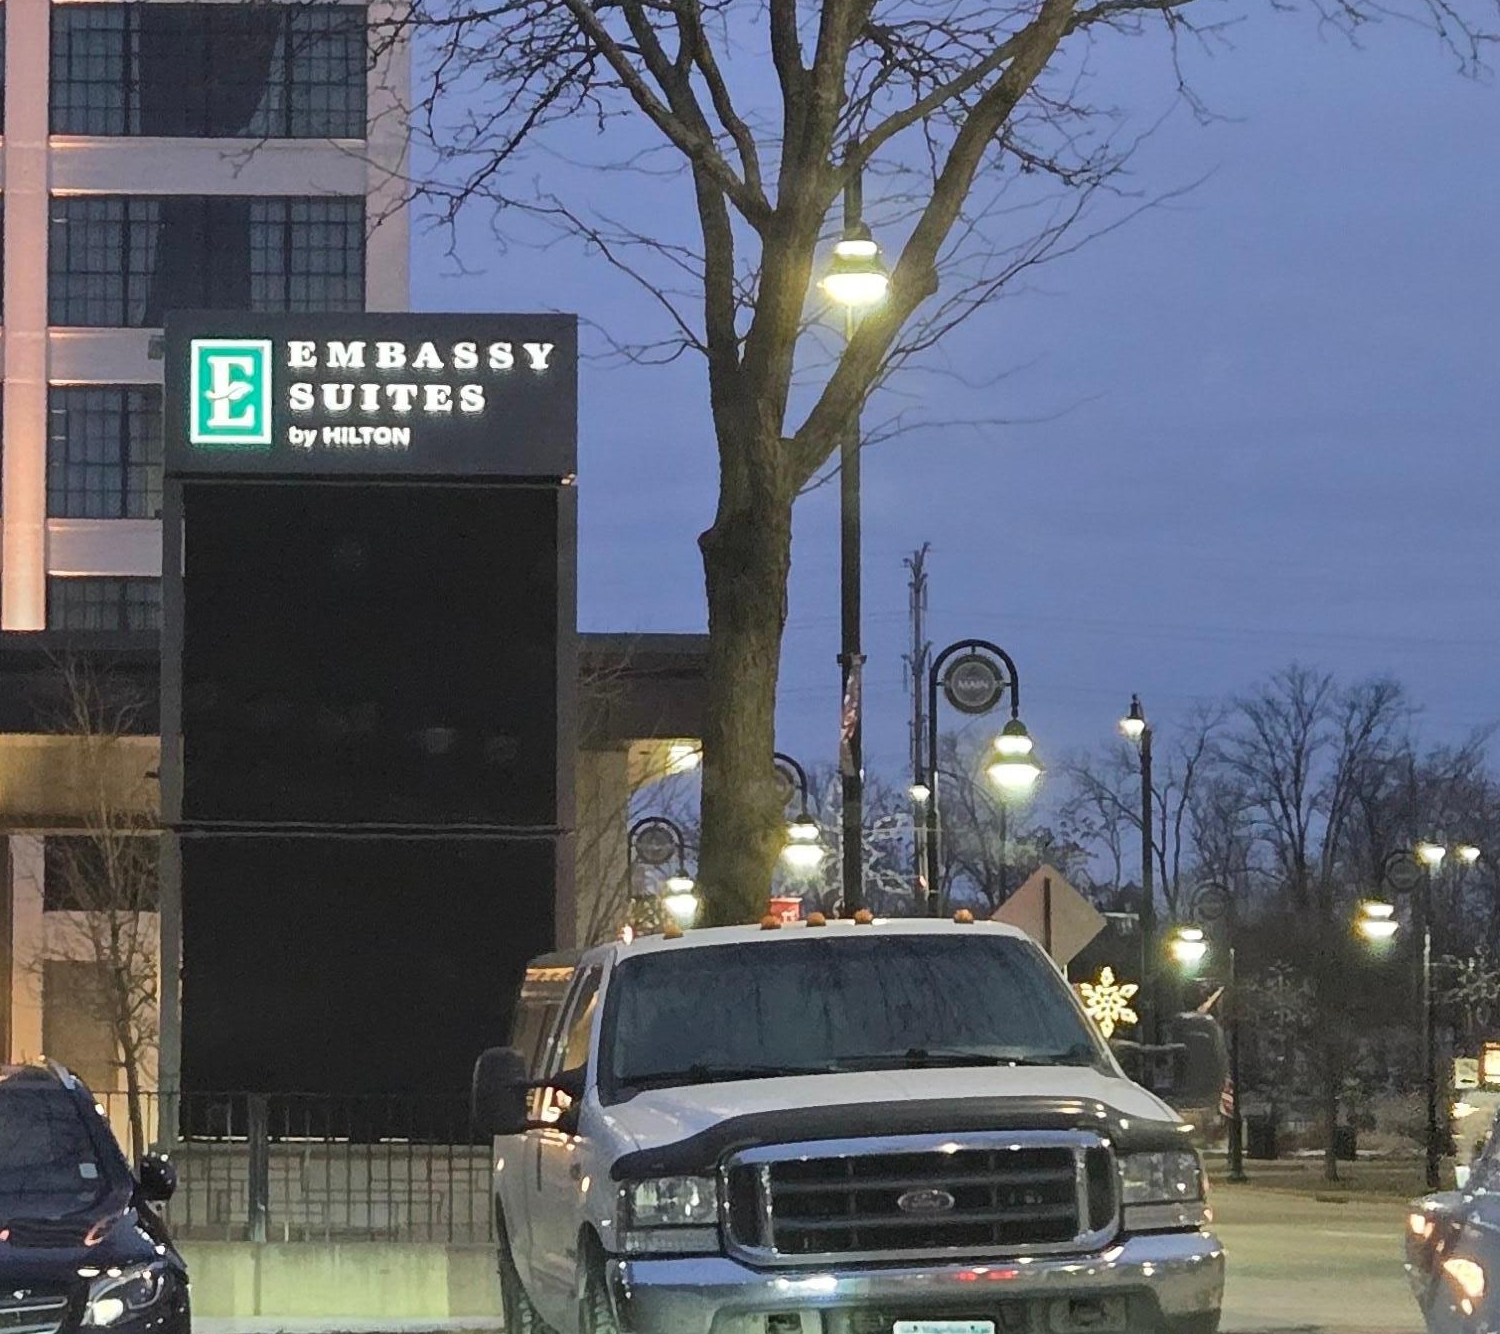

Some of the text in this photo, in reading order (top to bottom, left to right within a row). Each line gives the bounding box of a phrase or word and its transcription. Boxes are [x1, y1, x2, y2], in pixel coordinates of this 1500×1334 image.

[287, 340, 555, 370] EMBASSY
[289, 382, 486, 412] SUITES
[288, 425, 411, 448] by HILTON
